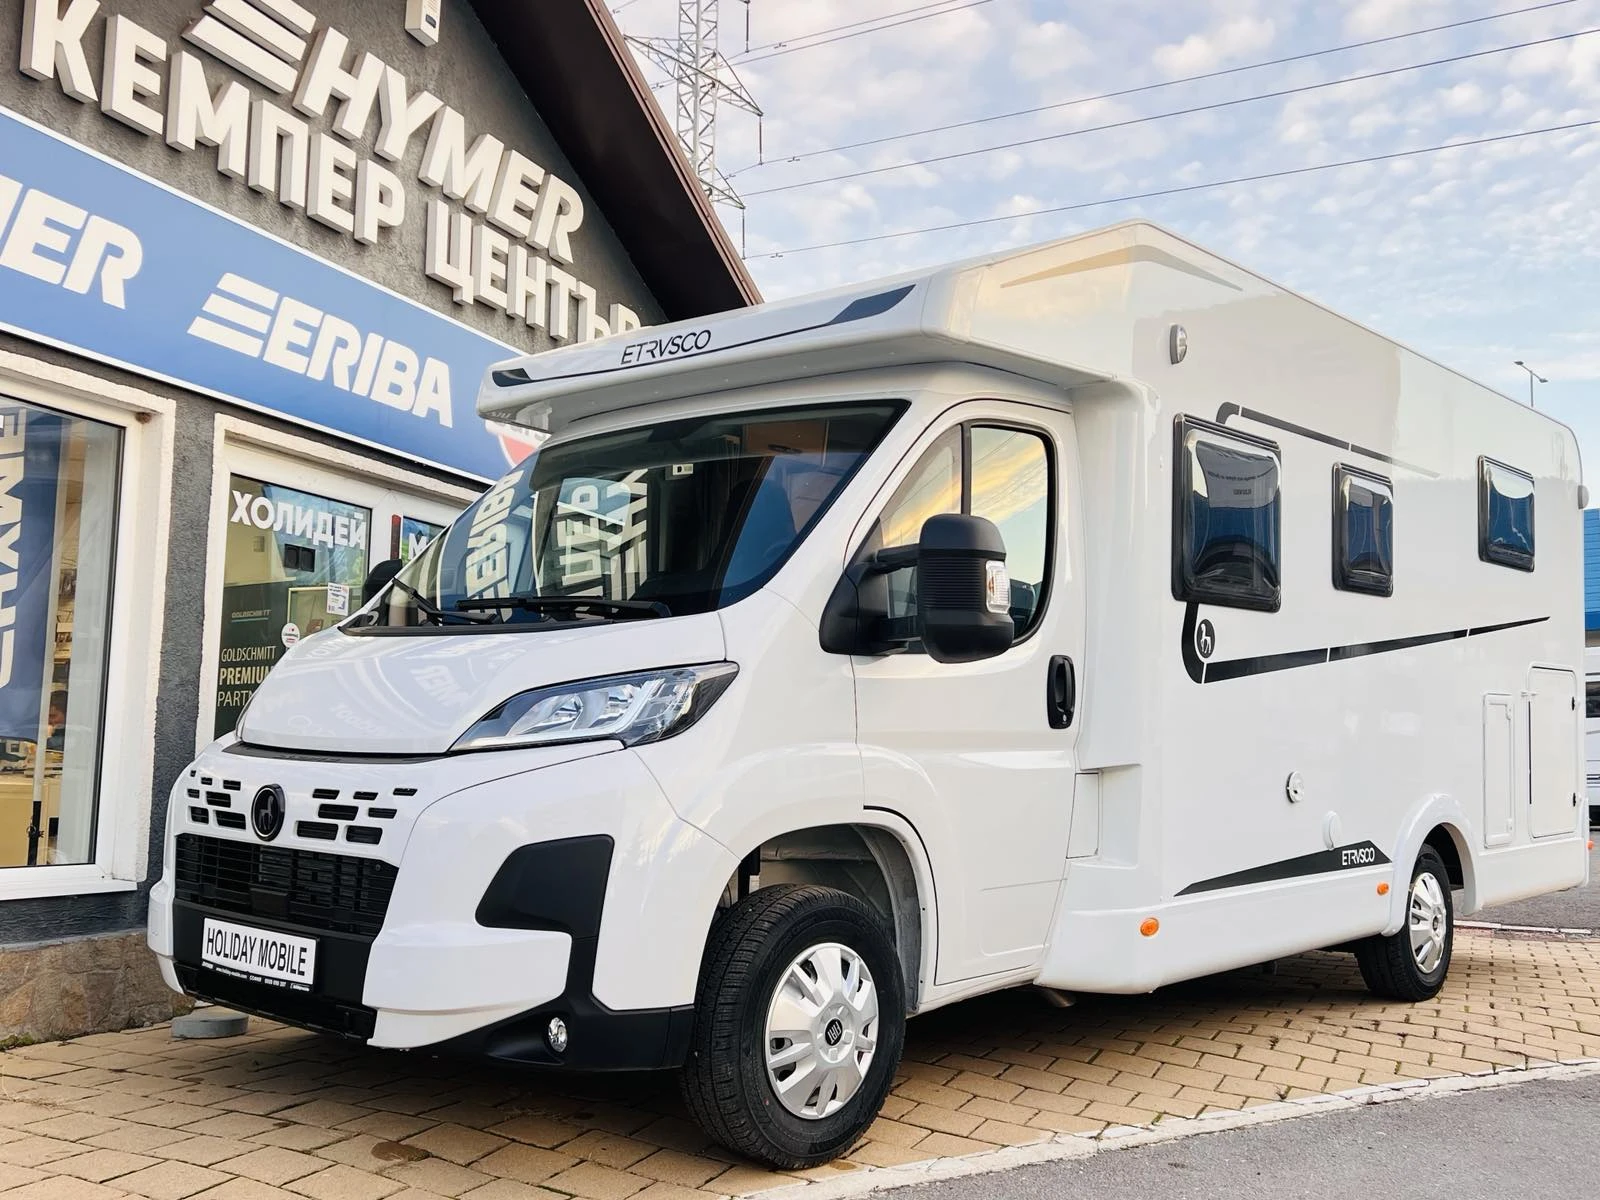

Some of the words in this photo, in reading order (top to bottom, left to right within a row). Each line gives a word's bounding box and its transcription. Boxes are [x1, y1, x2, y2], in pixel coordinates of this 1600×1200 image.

[19, 0, 405, 245] КЕМПЕР
[292, 27, 584, 264] HYMER
[263, 296, 453, 428] ERIBA
[230, 490, 367, 550] ХОЛИДЕЙ
[221, 646, 277, 662] GOLDSCHMITT
[206, 927, 257, 964] HOLIDAY
[257, 938, 308, 977] MOBILE
[827, 1021, 842, 1045] FIAT
